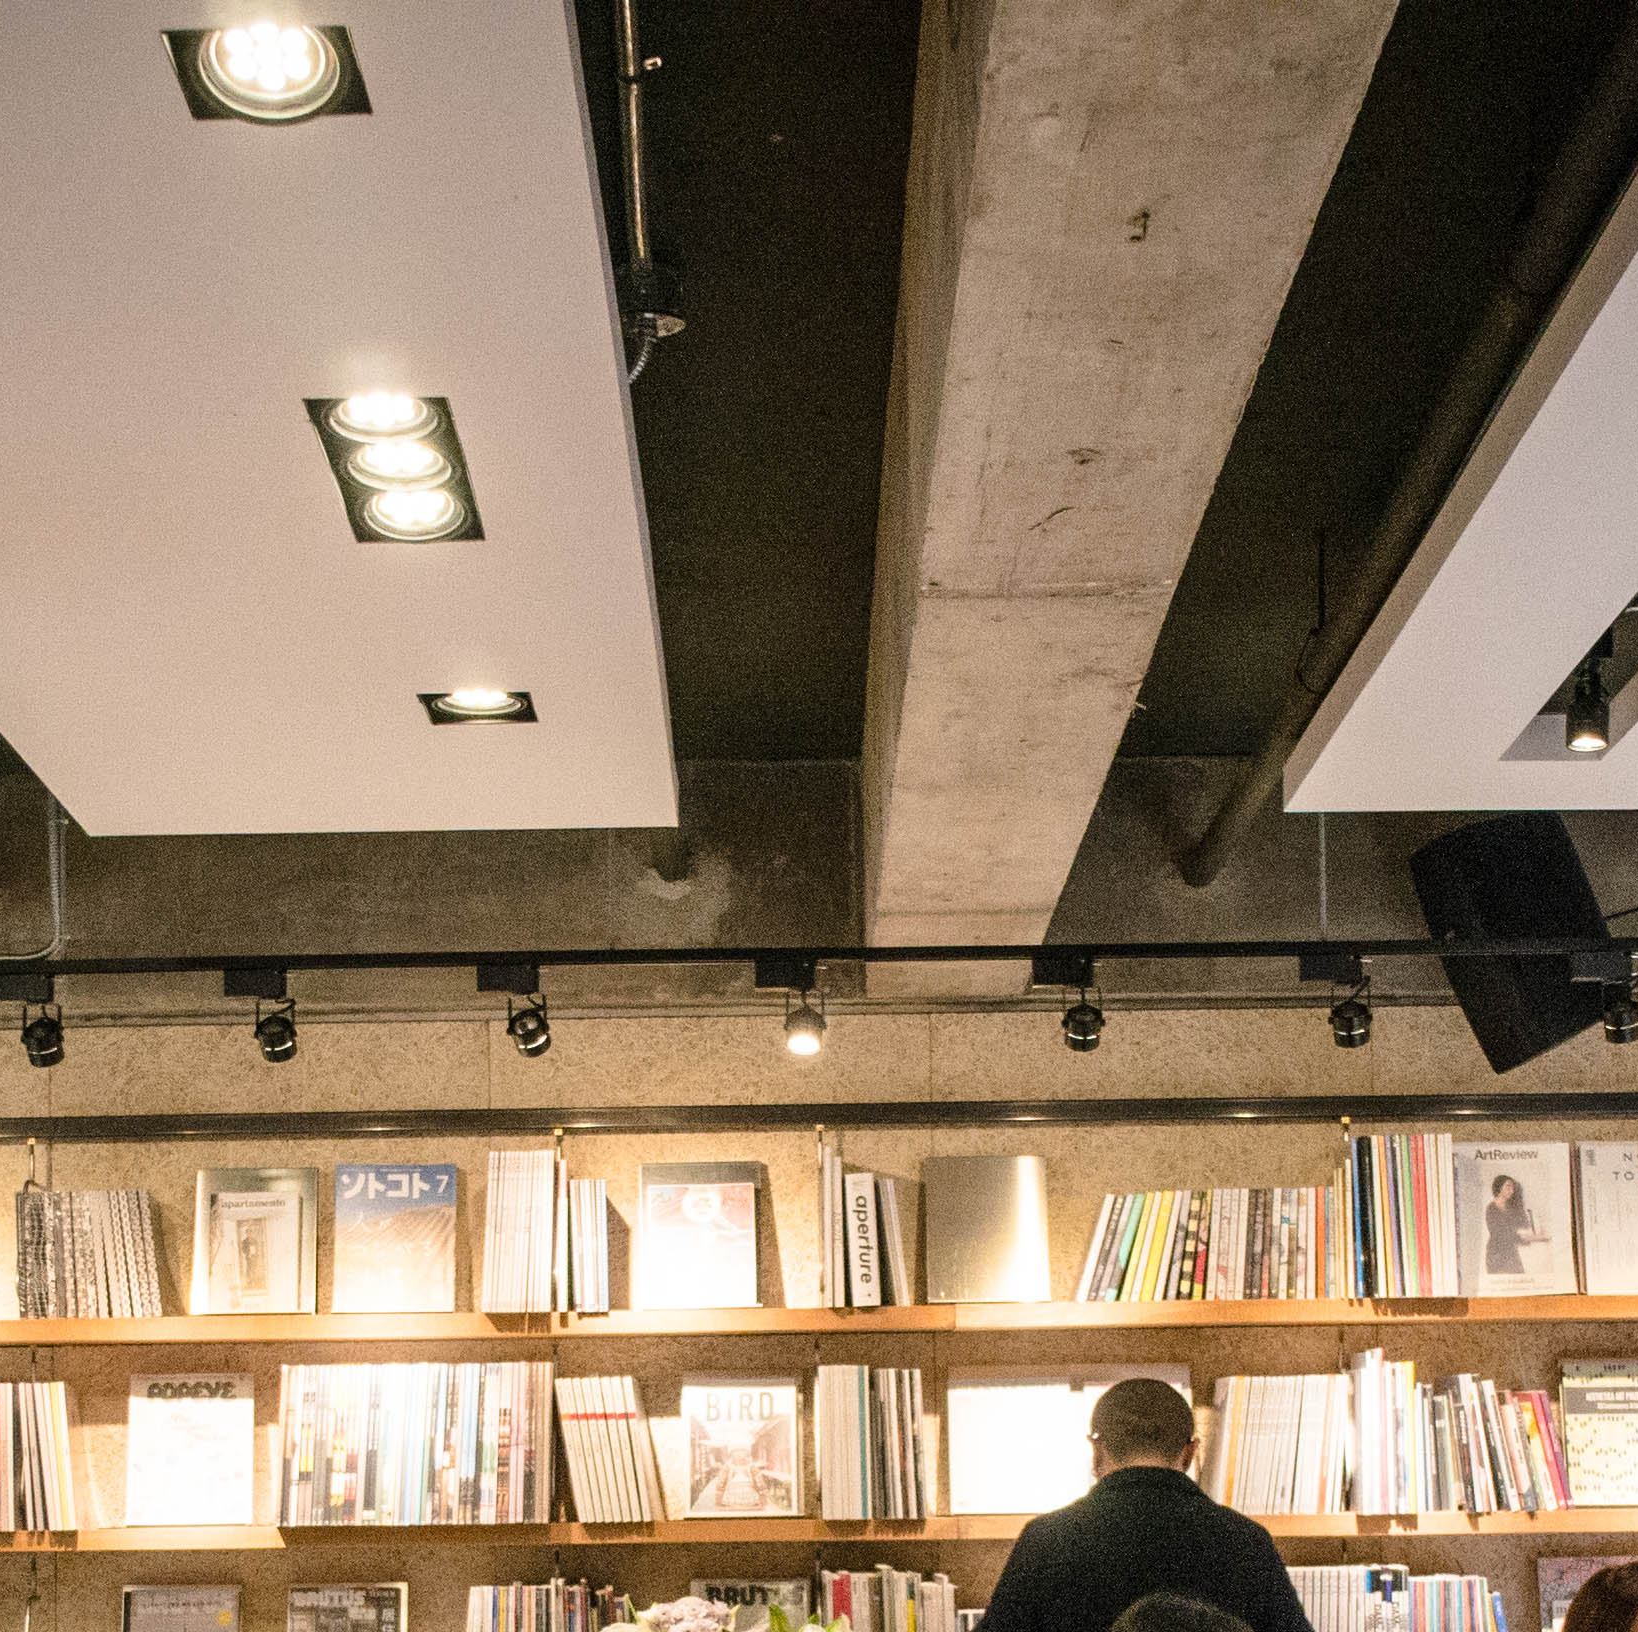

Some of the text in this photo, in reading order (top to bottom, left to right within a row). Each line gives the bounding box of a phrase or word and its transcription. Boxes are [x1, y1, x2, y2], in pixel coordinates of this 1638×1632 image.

[1474, 1149, 1539, 1161] ArtReview
[341, 1172, 449, 1200] ソトコト 7
[221, 1198, 286, 1209] apartamento
[855, 1195, 875, 1284] aperture
[147, 1382, 237, 1399] POPEYE
[293, 1591, 366, 1607] BRUTUS
